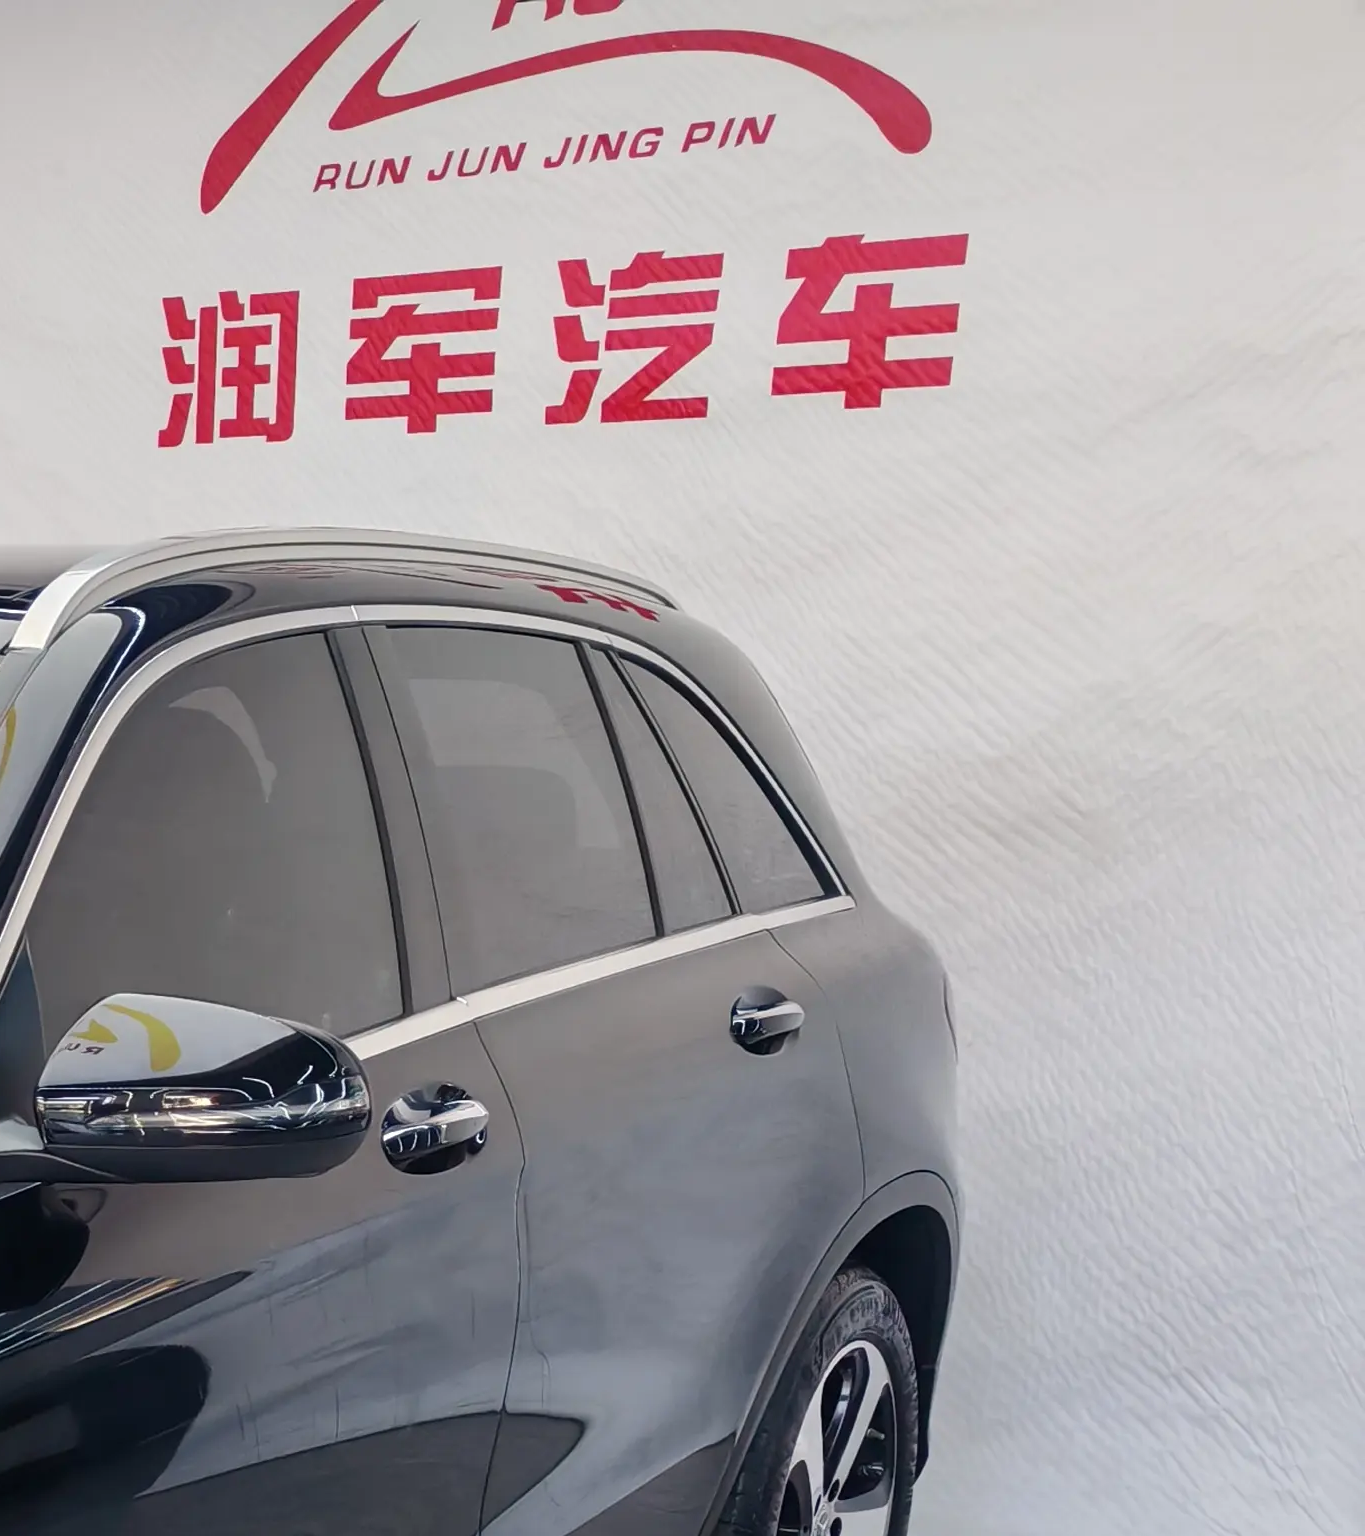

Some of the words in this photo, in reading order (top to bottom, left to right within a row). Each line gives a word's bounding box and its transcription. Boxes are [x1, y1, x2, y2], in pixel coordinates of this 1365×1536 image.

[313, 156, 411, 194] RUN
[427, 142, 527, 182] JUN
[543, 126, 663, 169] JING
[681, 113, 777, 153] PIN
[158, 233, 969, 448] 润军汽车
